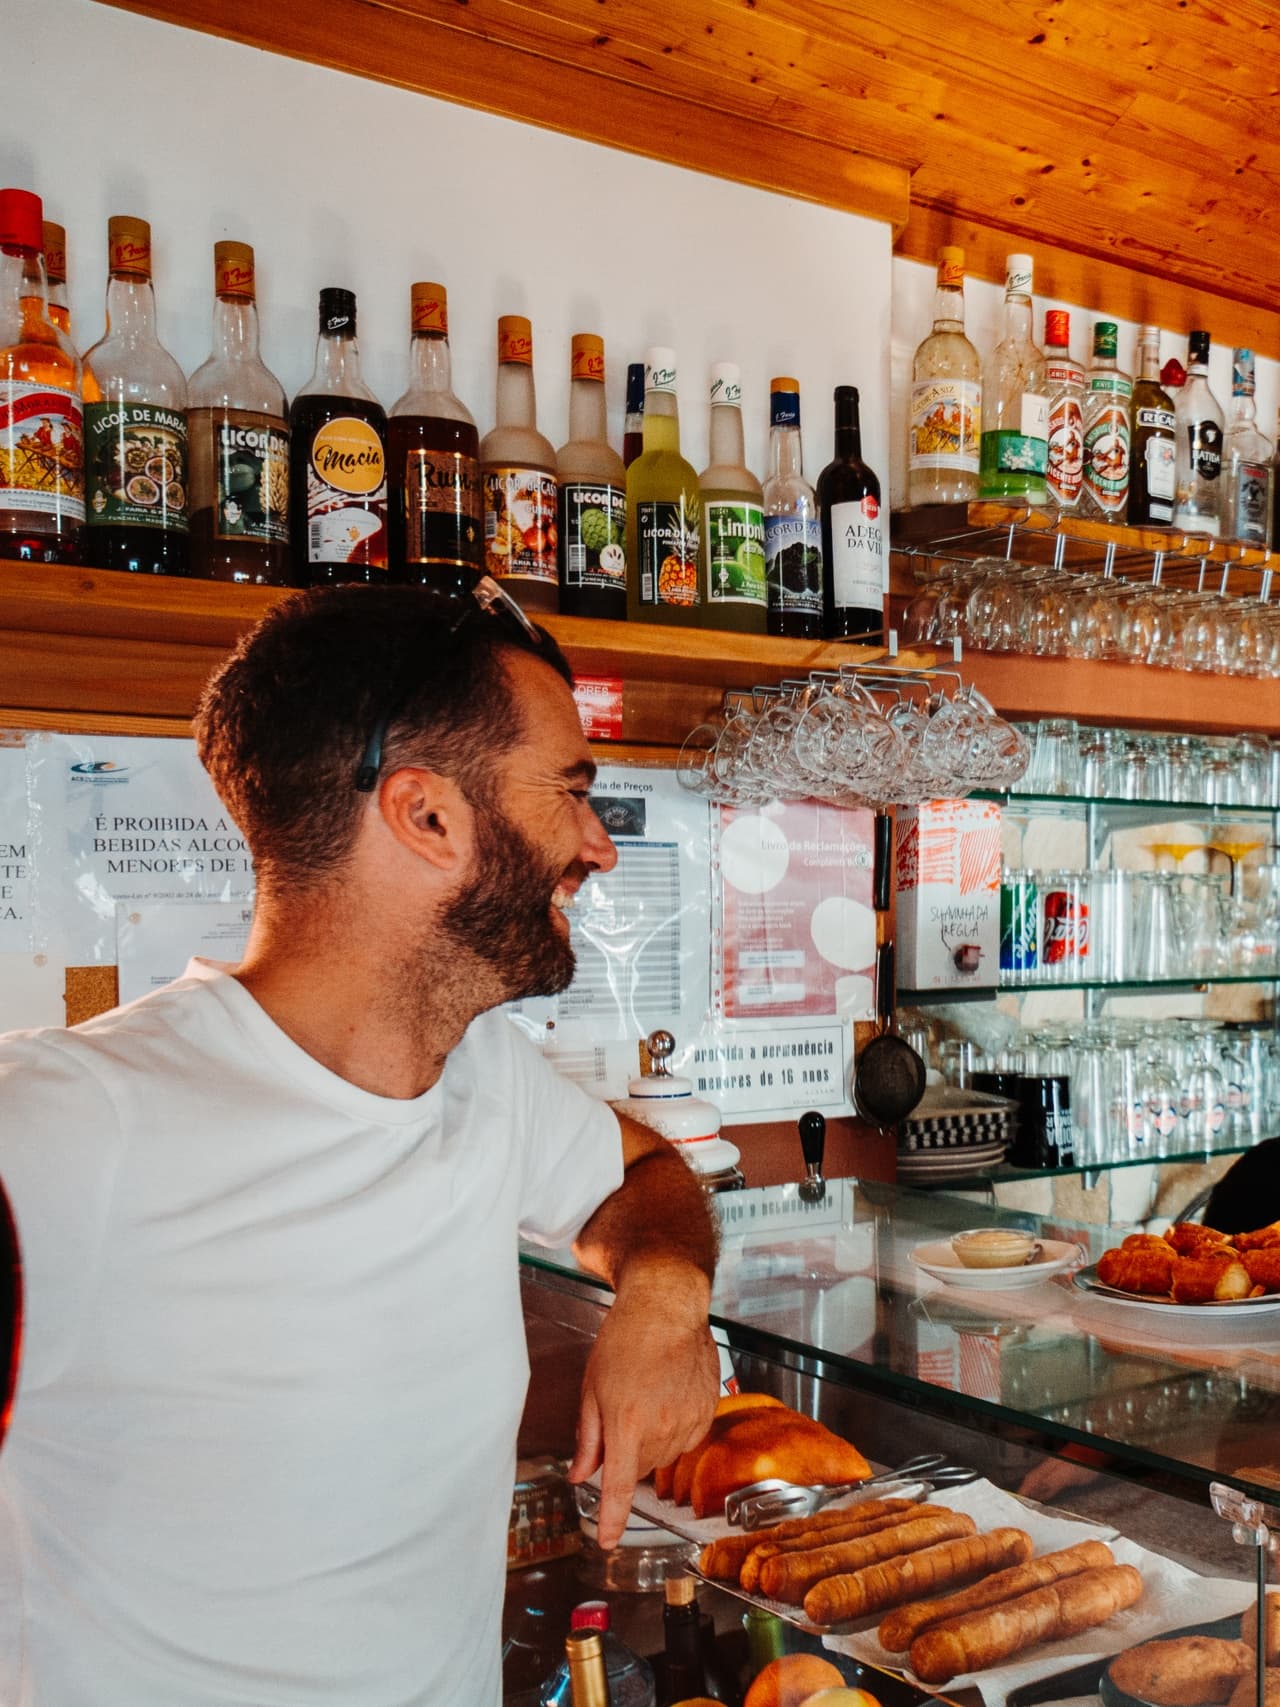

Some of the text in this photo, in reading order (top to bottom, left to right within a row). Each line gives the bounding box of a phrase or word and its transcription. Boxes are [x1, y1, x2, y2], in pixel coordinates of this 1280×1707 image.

[92, 411, 129, 435] LICOR
[133, 409, 150, 422] DE
[221, 429, 268, 448] LICOR
[315, 445, 382, 474] Macia
[573, 492, 608, 505] LICOR
[643, 529, 671, 539] LICOR
[847, 538, 864, 549] DA
[610, 781, 620, 790] de
[624, 782, 653, 793] Preços
[95, 813, 229, 832] É PROIBIDA A
[93, 838, 182, 852] BEBIDAS
[1, 865, 26, 879] TE
[107, 858, 205, 873] MENORES
[211, 858, 236, 873] DE
[750, 1047, 756, 1060] a
[762, 1040, 834, 1059] permanência
[698, 1068, 830, 1091] menores de 16 anos
